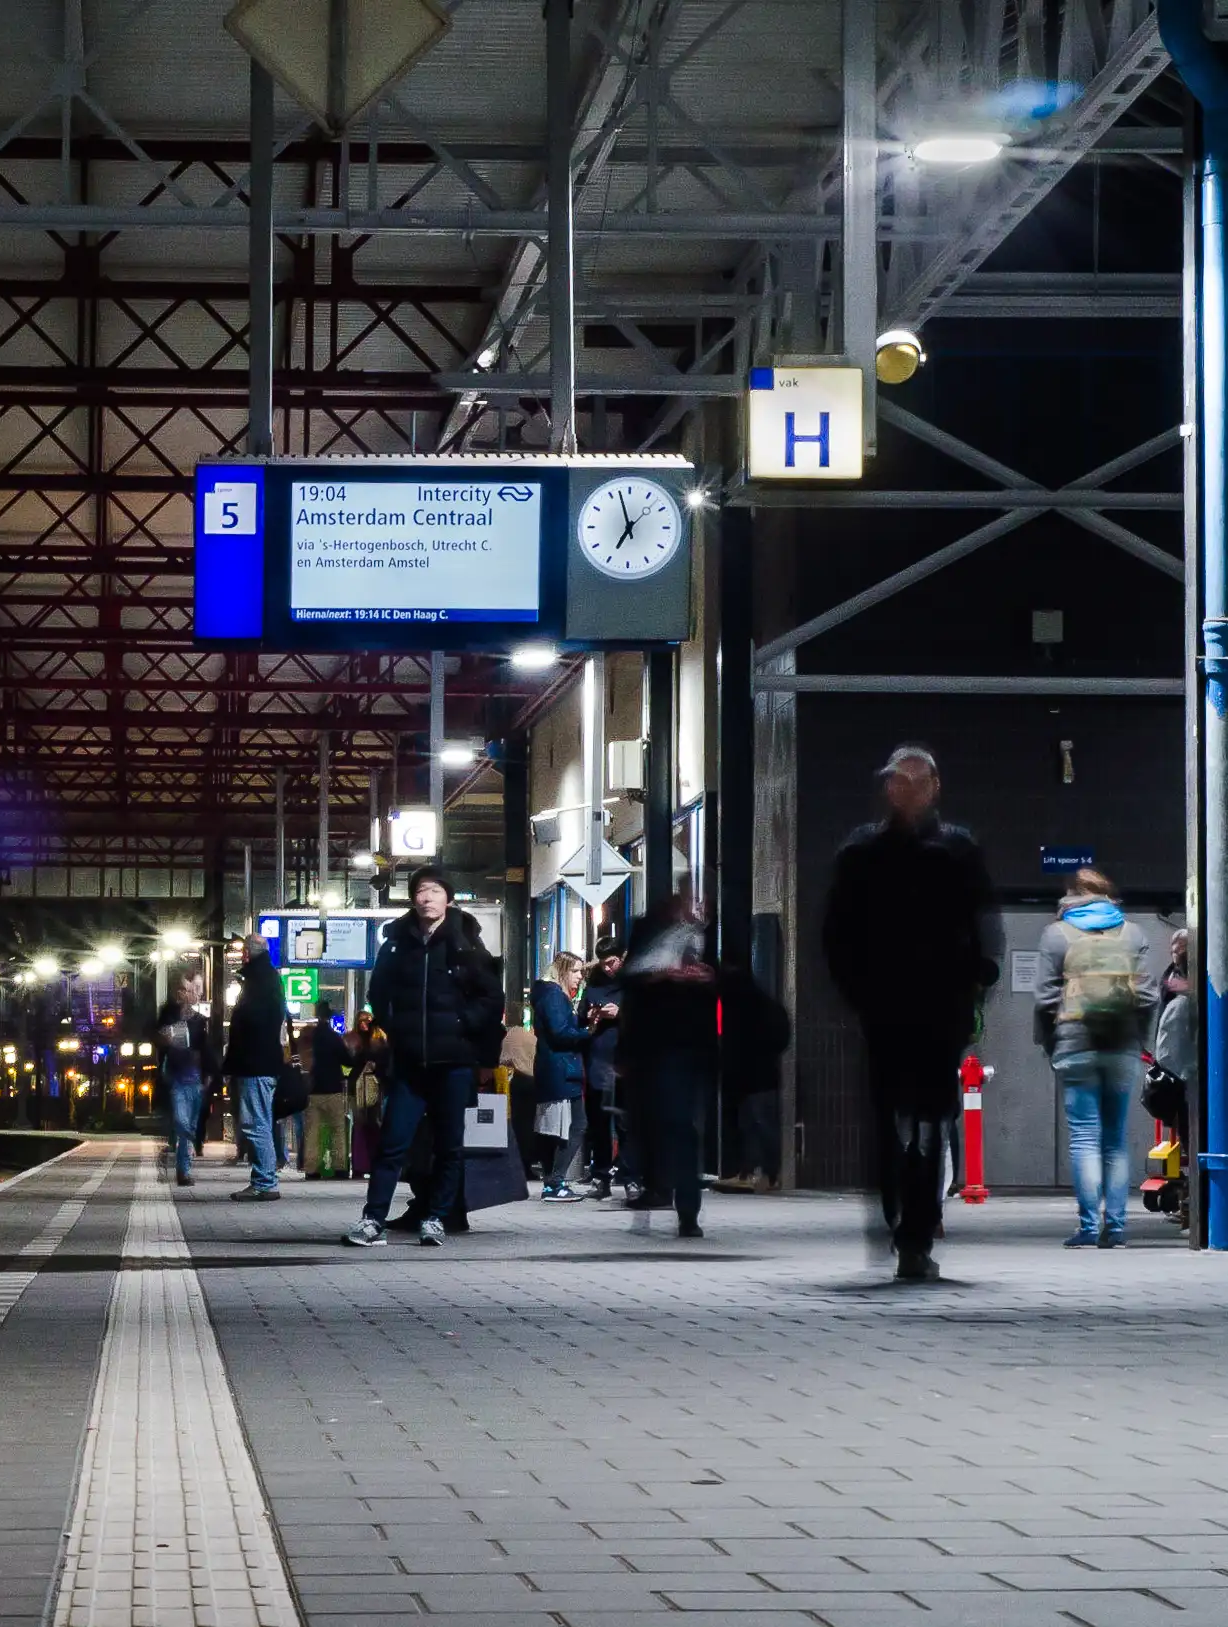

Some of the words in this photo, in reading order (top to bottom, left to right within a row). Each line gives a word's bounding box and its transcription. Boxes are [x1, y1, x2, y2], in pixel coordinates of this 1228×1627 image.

[779, 377, 799, 388] vak
[784, 411, 830, 468] H
[298, 485, 347, 502] 19:04
[417, 485, 492, 506] Intercity
[221, 502, 239, 529] 5
[295, 508, 406, 526] Amsterdam
[412, 508, 493, 526] Centraal
[296, 539, 315, 551] via
[432, 539, 477, 551] Utrecht
[481, 539, 493, 551] C.
[296, 559, 311, 568] en
[315, 557, 385, 568] Amsterdam
[388, 556, 430, 568] Amstel
[295, 608, 352, 620] Hierna/next:
[354, 608, 380, 620] 19:14
[381, 609, 391, 620] IC
[393, 609, 411, 620] Den
[413, 609, 437, 622] Haag
[439, 609, 449, 620] C.
[402, 825, 424, 850] G
[306, 942, 315, 956] F
